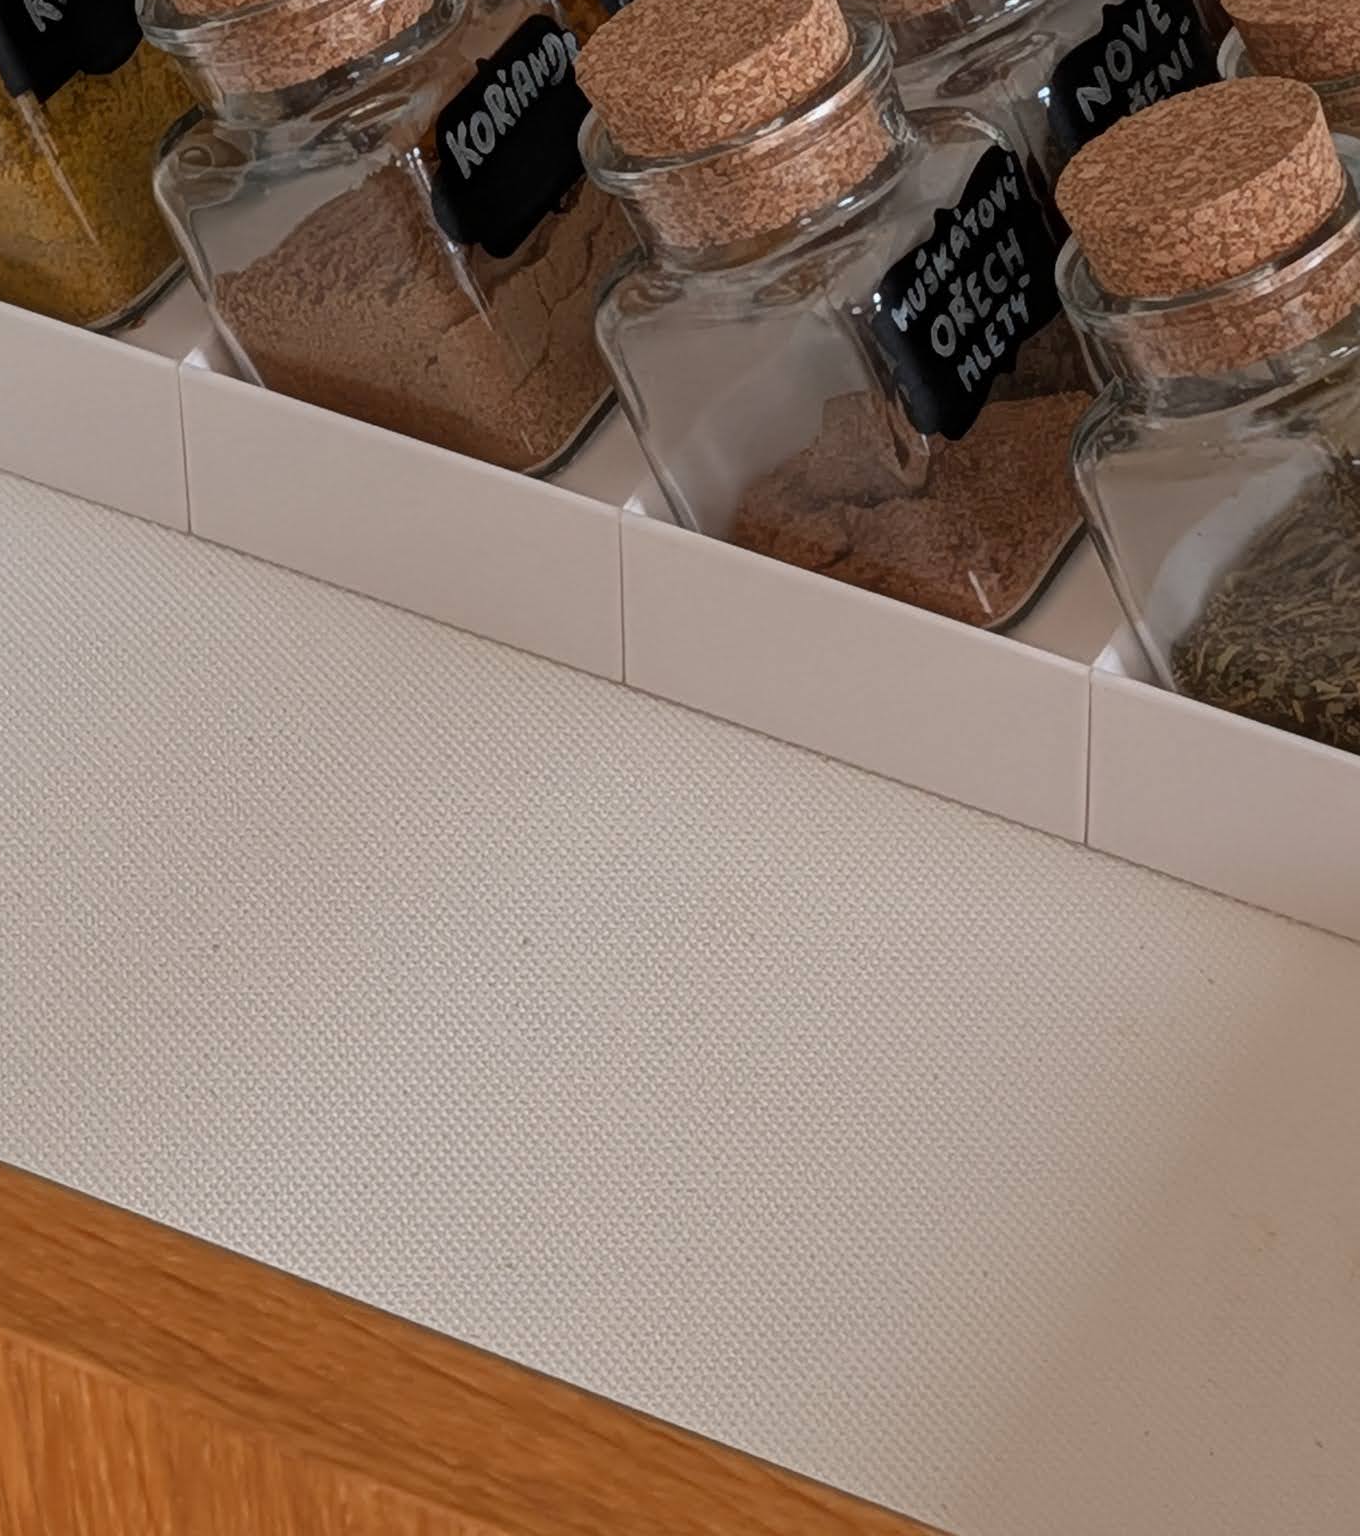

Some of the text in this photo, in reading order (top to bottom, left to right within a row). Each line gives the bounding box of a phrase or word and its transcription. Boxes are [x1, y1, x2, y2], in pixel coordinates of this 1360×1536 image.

[891, 155, 1019, 332] MUŠKÁTOVÝ
[931, 228, 1025, 357] OŘECH
[958, 273, 1031, 392] MLETÝ
